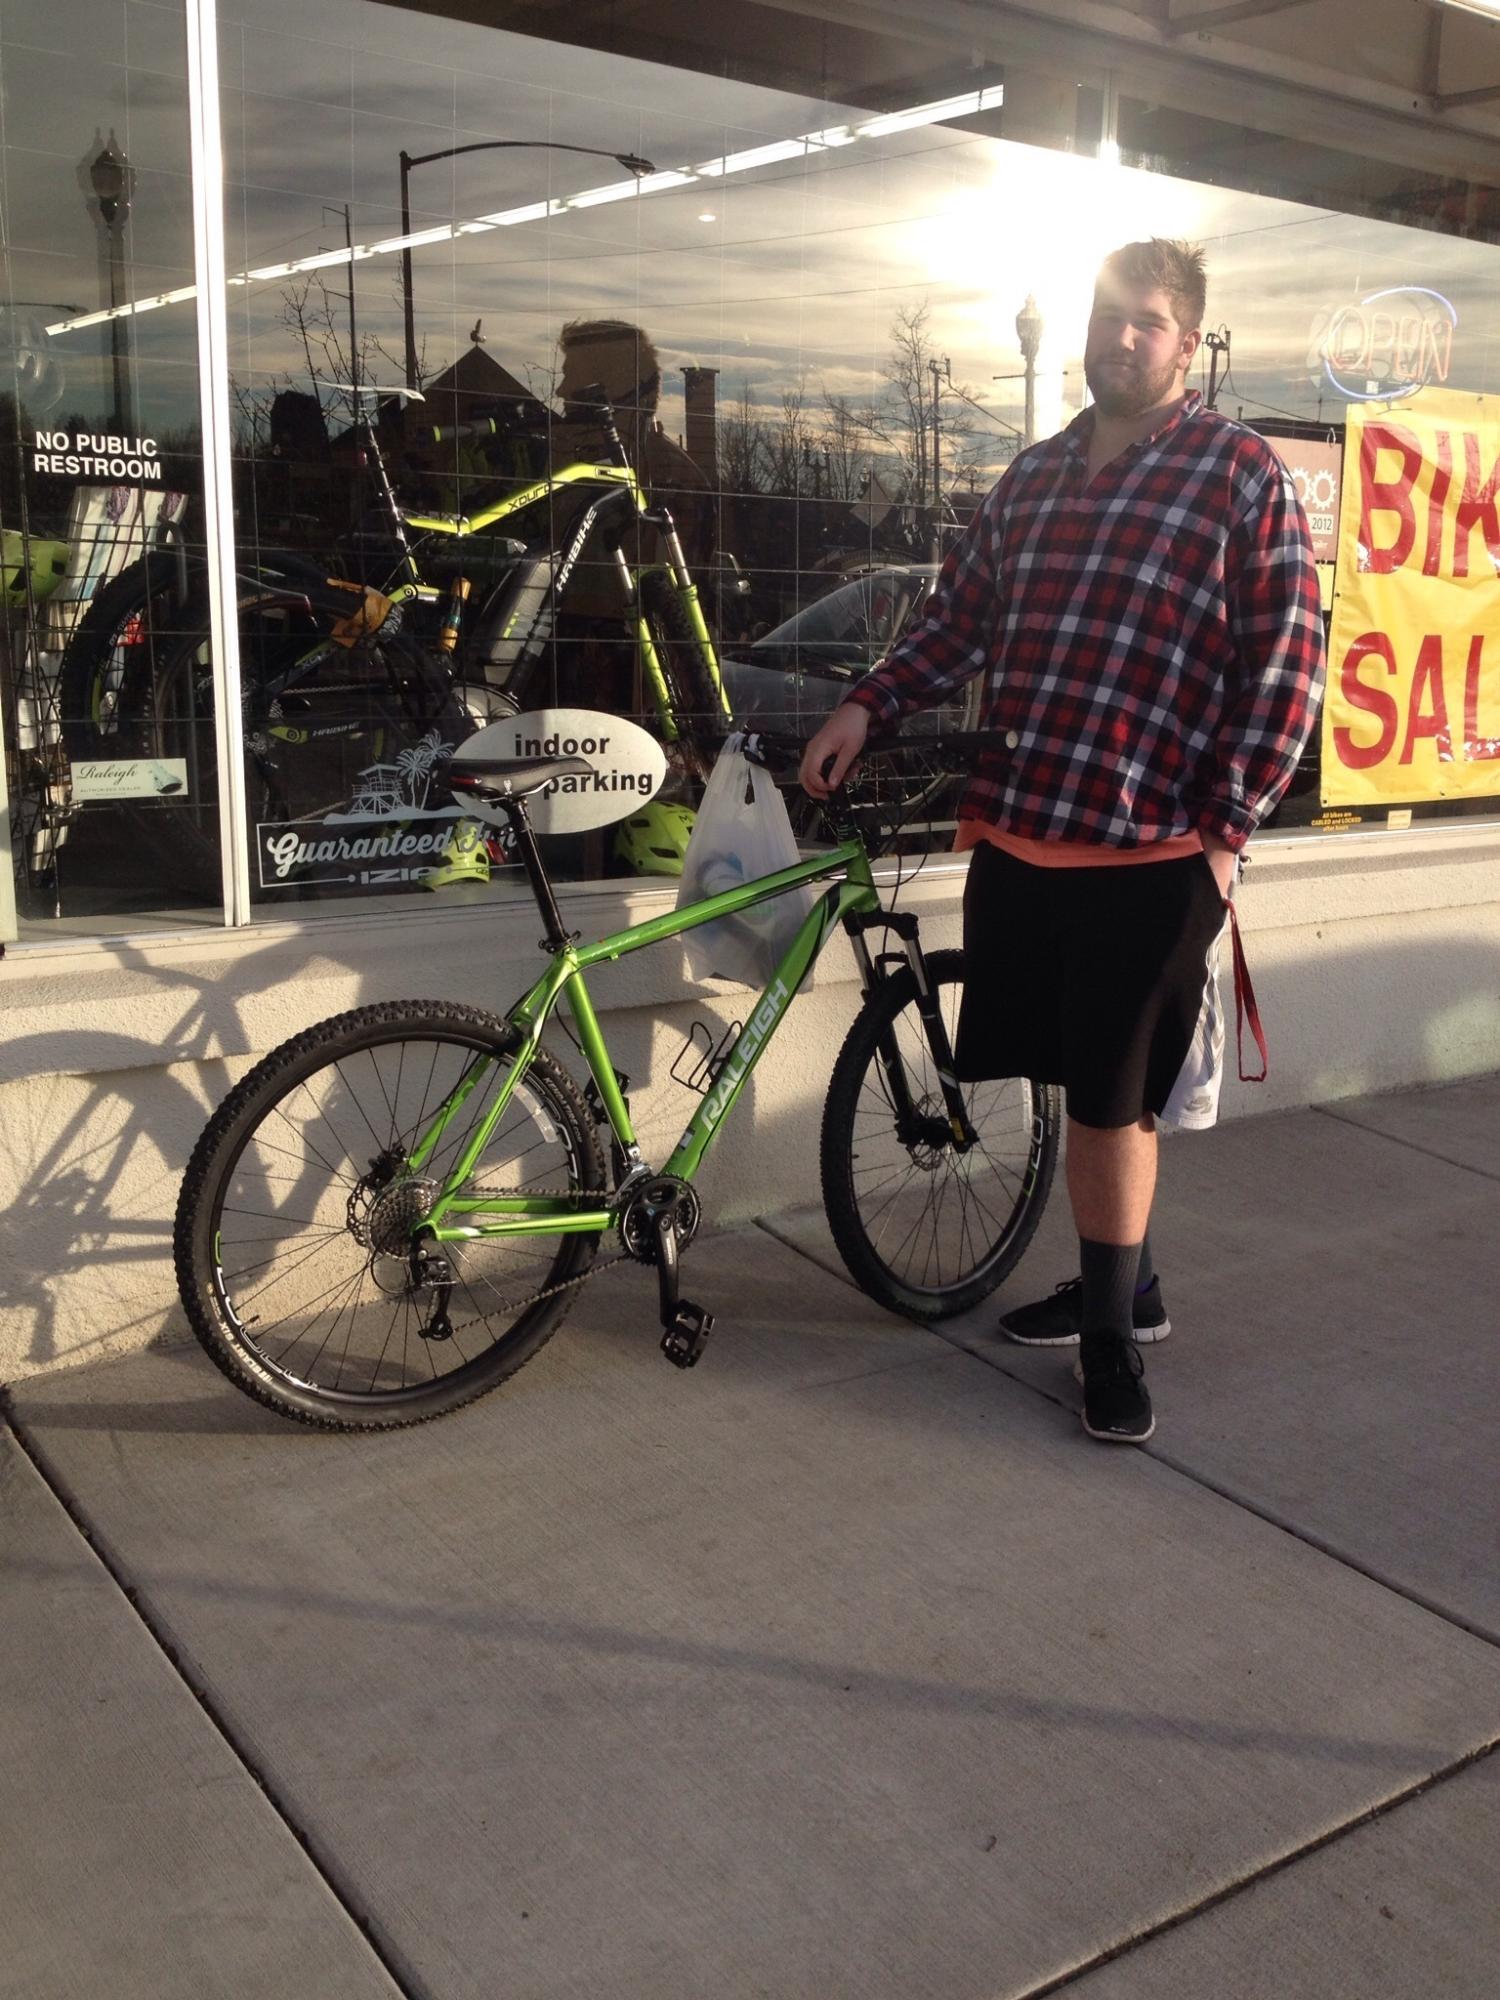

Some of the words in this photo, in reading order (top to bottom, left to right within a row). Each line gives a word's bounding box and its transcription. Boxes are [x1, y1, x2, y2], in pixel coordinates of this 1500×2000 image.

[1328, 306, 1453, 382] OPEN
[36, 431, 69, 451] NO
[76, 433, 157, 457] PUBLIC
[34, 453, 161, 479] RESTROOM
[1311, 517, 1332, 531] 2012
[556, 505, 597, 592] HAIBIKE
[515, 733, 610, 757] indoor
[79, 764, 138, 786] Raleigh
[544, 769, 653, 800] parking
[267, 822, 453, 878] Guaranteed
[701, 978, 789, 1132] RALEIGH
